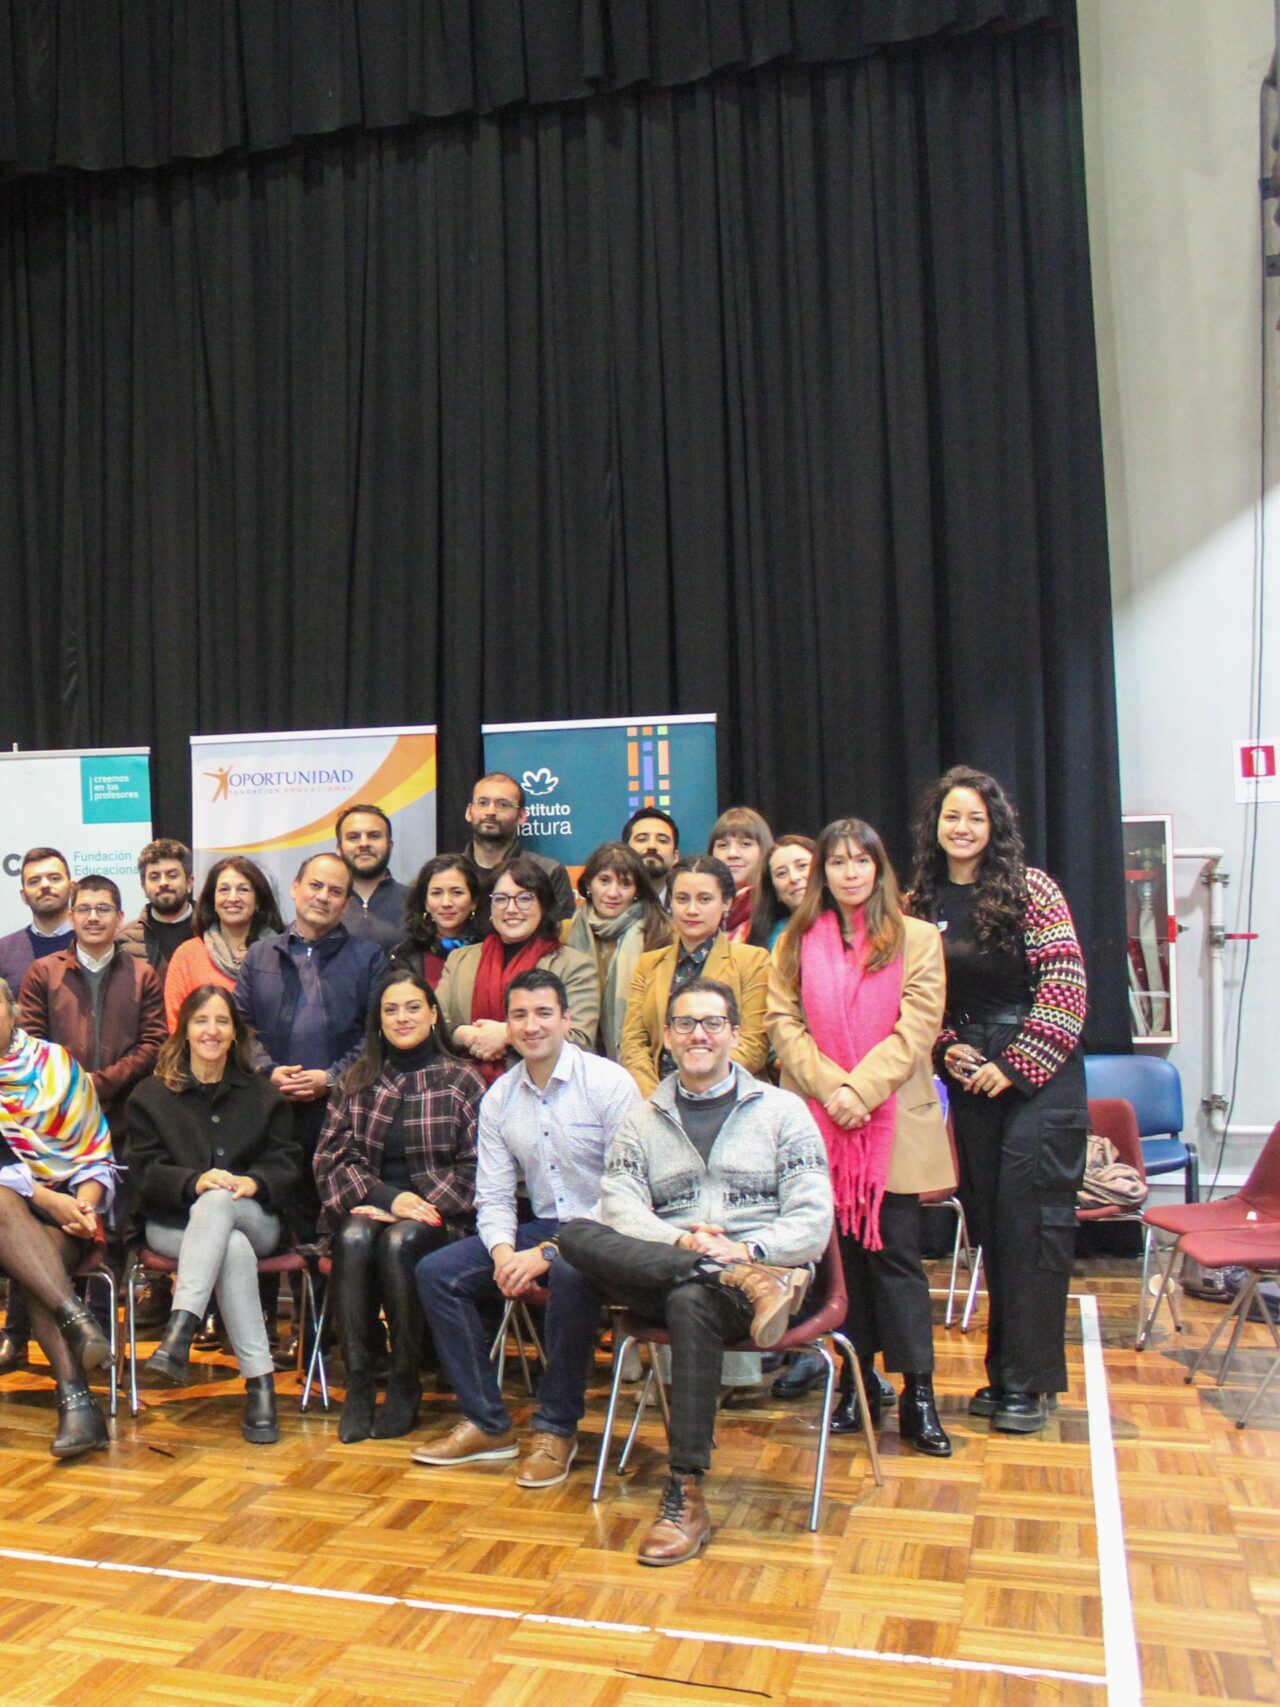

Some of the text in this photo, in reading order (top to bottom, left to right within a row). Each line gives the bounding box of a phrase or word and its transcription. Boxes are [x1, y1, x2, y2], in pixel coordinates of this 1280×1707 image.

[93, 775, 129, 783] creemos
[229, 769, 354, 787] OPORTUNIDAD
[106, 782, 119, 791] los
[94, 790, 139, 801] profesores
[524, 802, 571, 816] stituto
[74, 850, 132, 861] Fundación
[75, 865, 139, 876] Educaciona
